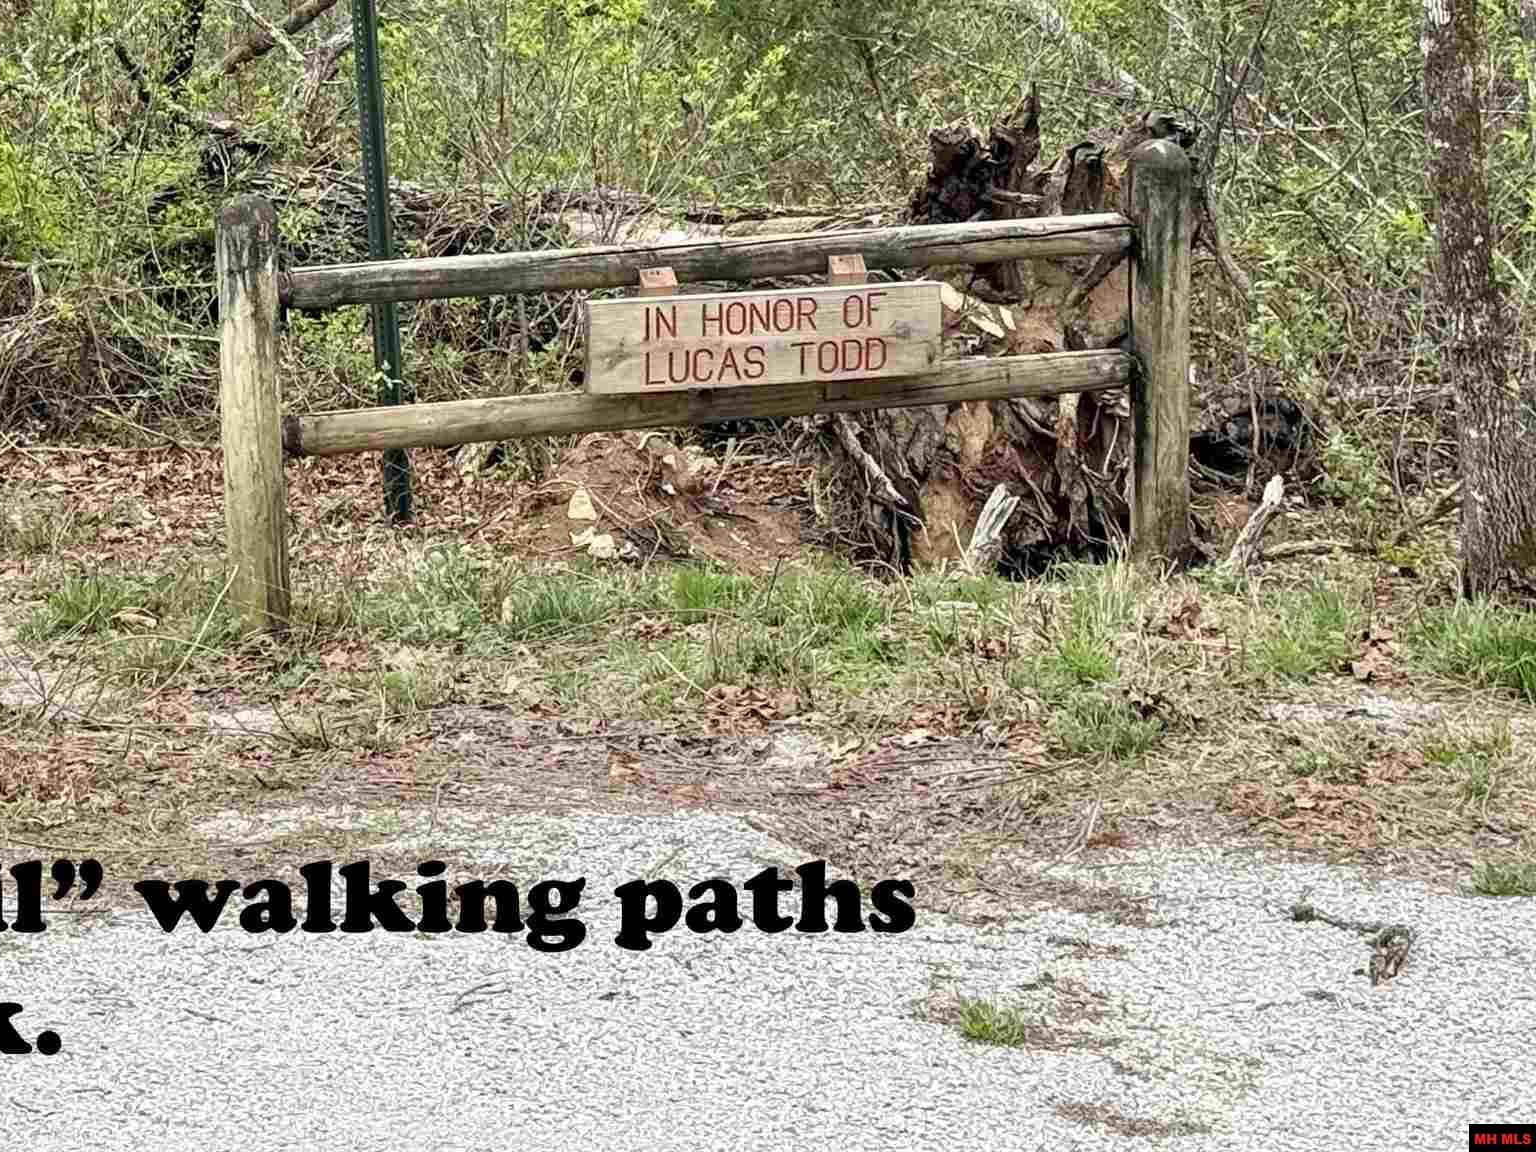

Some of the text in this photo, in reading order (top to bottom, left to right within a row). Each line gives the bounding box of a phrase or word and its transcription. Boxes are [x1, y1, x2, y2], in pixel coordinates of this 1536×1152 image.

[643, 292, 889, 341] IN HONOR OF
[644, 337, 888, 386] LUCAS TODD
